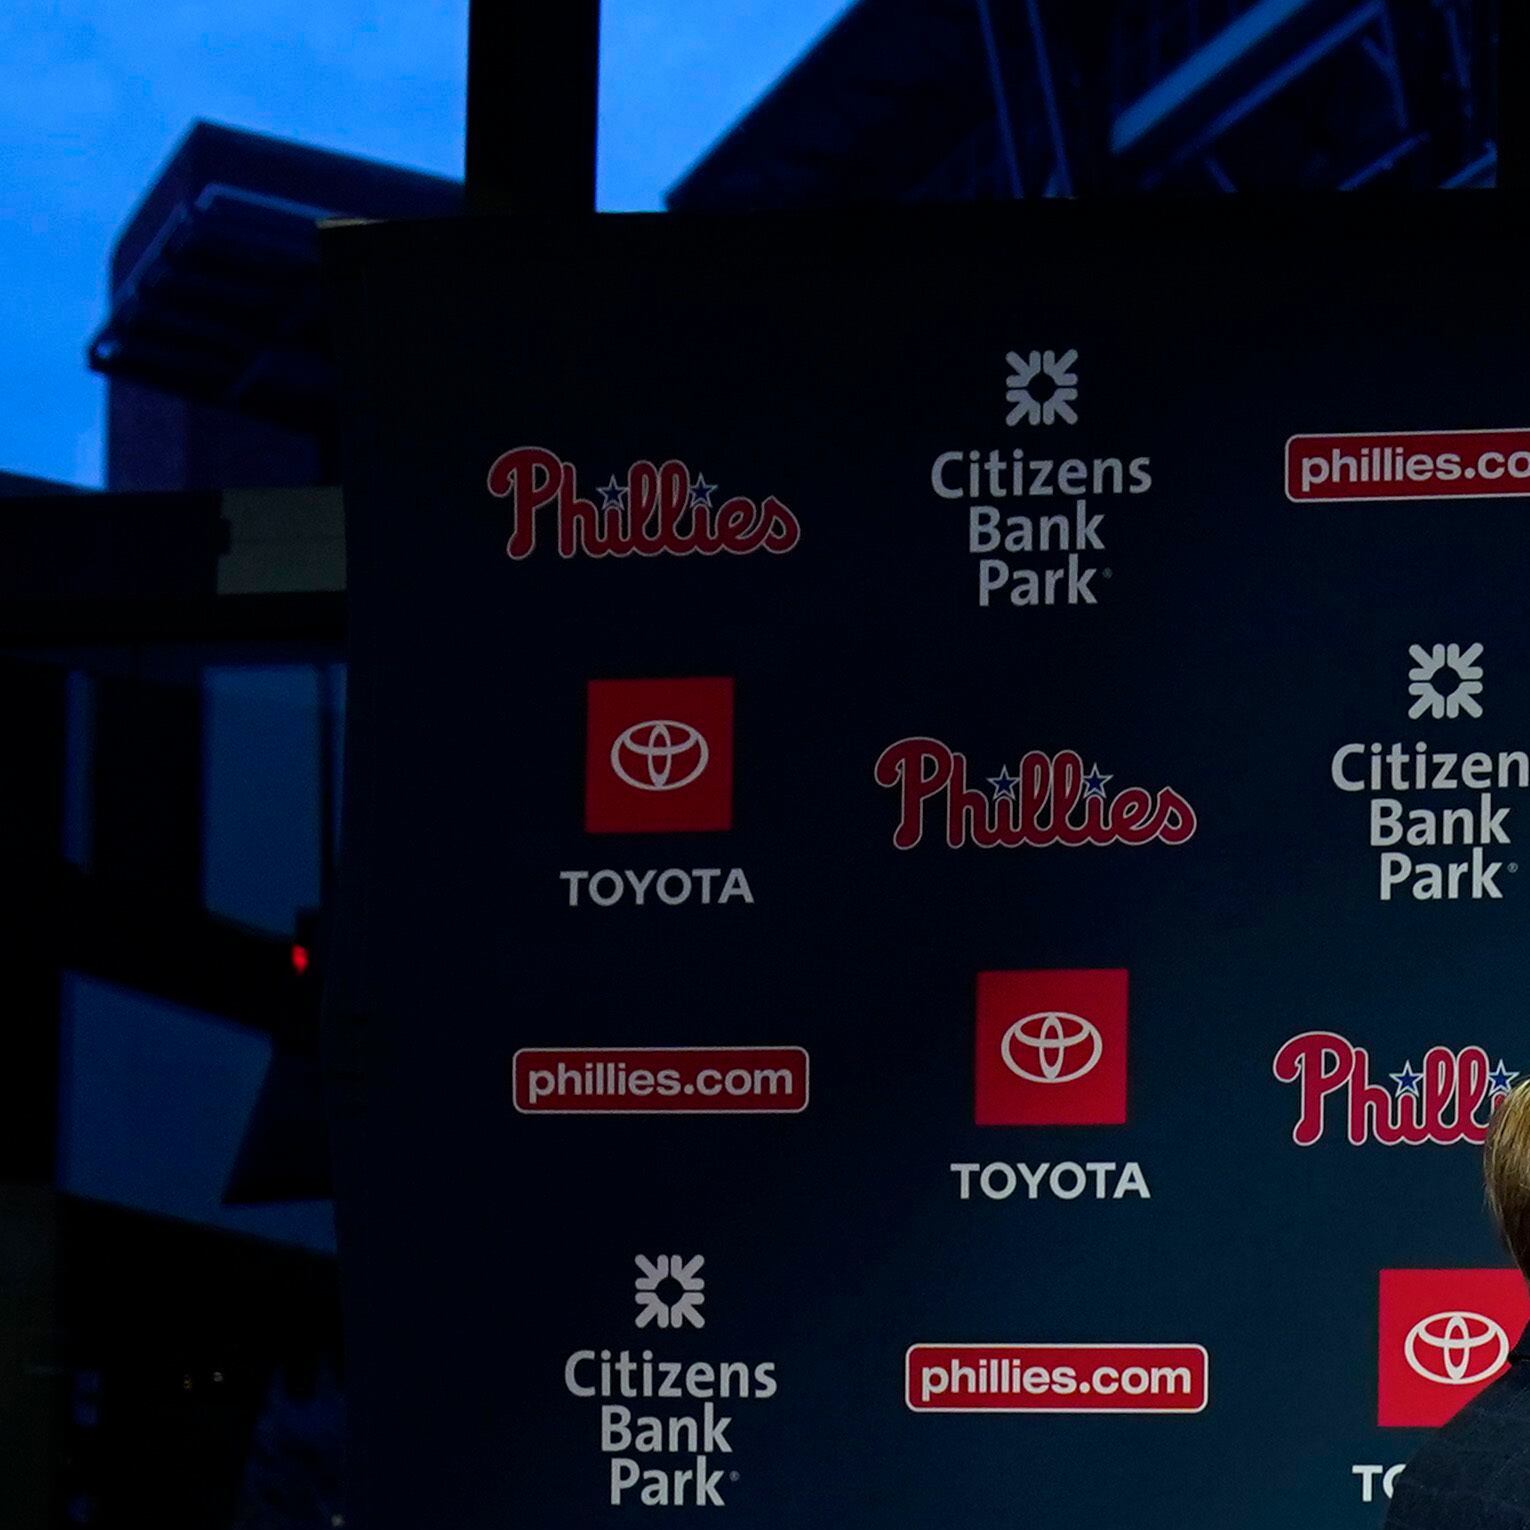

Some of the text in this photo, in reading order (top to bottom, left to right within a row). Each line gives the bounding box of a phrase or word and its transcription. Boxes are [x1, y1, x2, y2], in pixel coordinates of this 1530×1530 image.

[932, 448, 1152, 498] Citizens
[487, 446, 801, 561] Phillies
[970, 500, 1105, 553] Bank
[980, 553, 1097, 606] Park
[874, 736, 1197, 850] Phillies
[1371, 795, 1511, 848] Bank
[560, 868, 754, 906] TOYOTA
[1381, 849, 1502, 900] Park
[529, 1063, 792, 1104] phillies.com
[951, 1162, 1150, 1199] TOYOTA
[565, 1350, 777, 1398] Citizens
[922, 1359, 1191, 1401] phillies.com
[602, 1402, 732, 1452] Bank
[611, 1455, 724, 1506] Park
